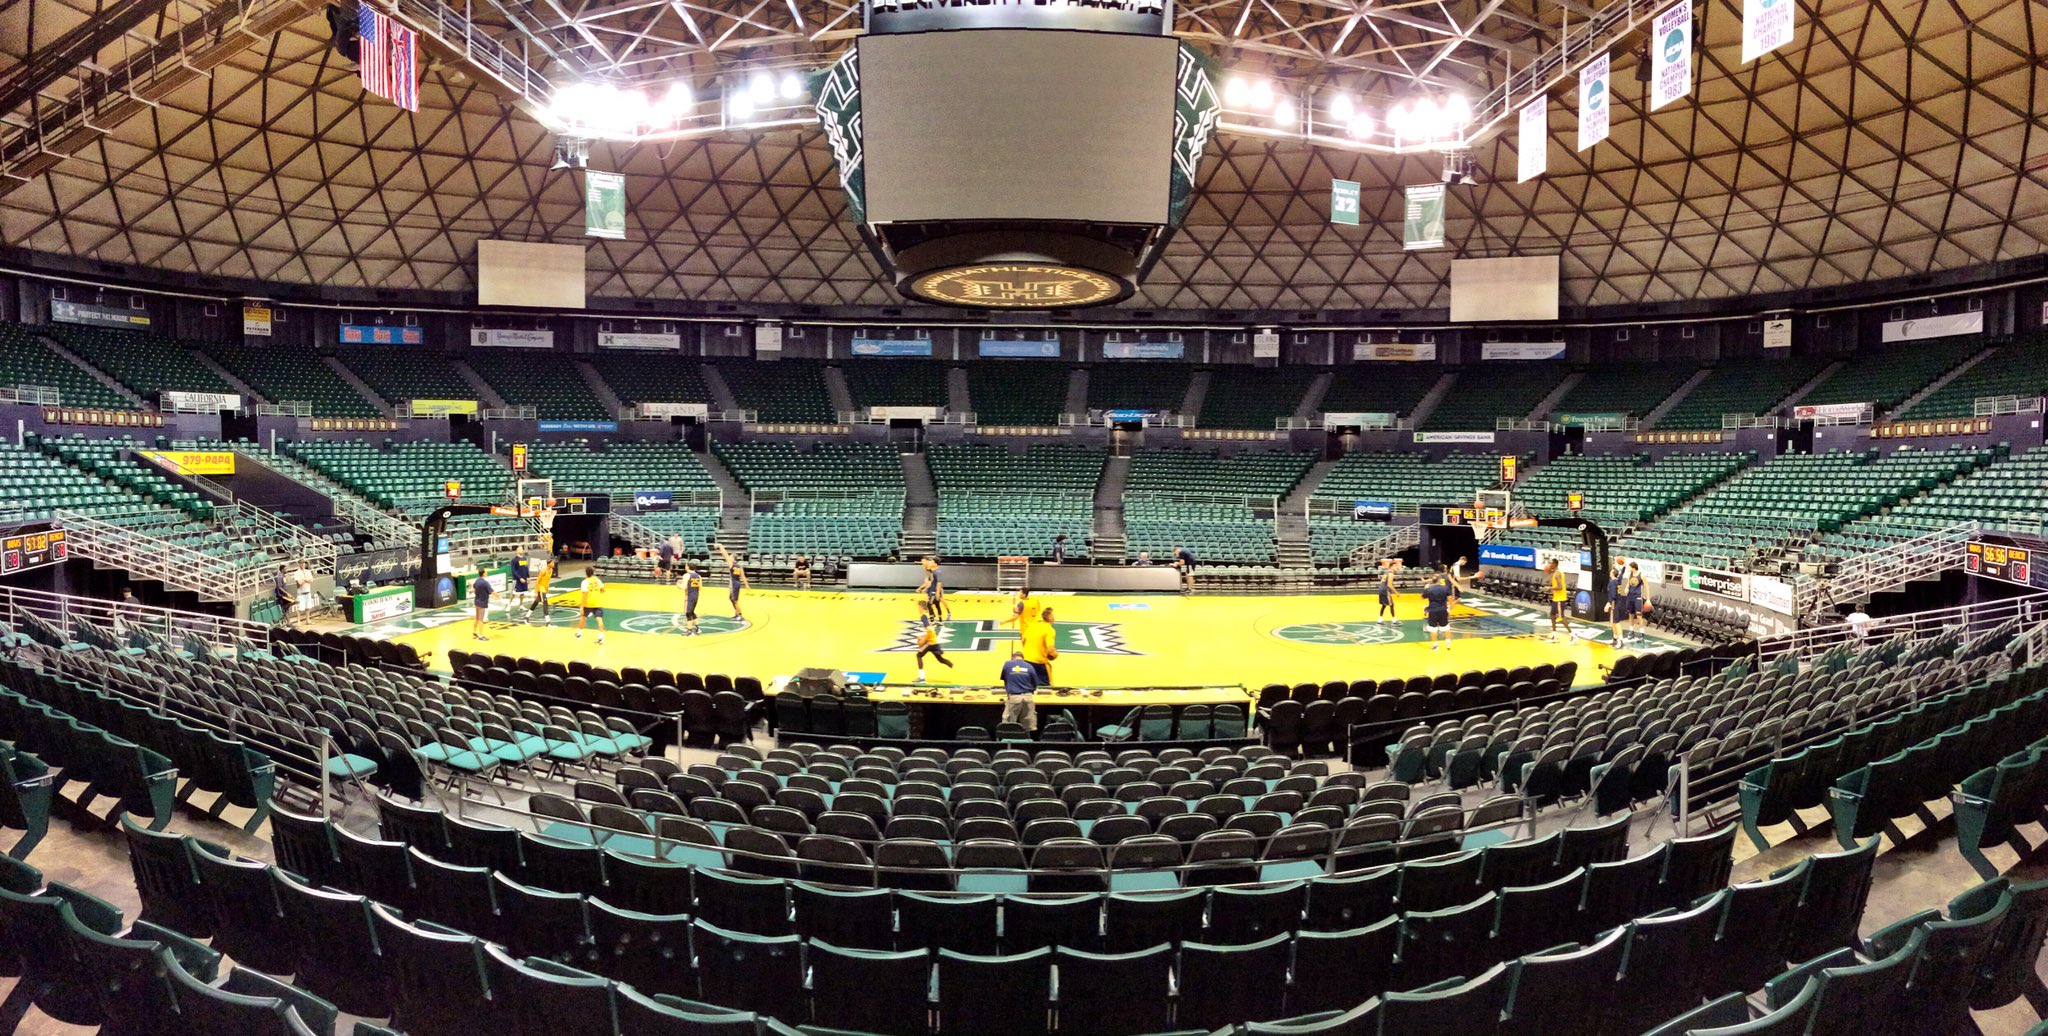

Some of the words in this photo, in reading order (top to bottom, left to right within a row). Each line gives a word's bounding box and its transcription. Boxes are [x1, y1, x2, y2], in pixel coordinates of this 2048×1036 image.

[1662, 3, 1687, 25] WOMEN'S
[1756, 2, 1787, 26] NATIONAL
[1659, 12, 1689, 36] VOLLEYBALL
[1754, 13, 1788, 39] CHAMPION
[1760, 29, 1781, 50] 1987
[1586, 57, 1607, 75] WOMEN'S
[1661, 59, 1686, 78] NATIONAL
[1660, 68, 1687, 90] CHAMPION
[1665, 82, 1682, 101] 1983
[184, 393, 227, 405] CALIFORNIA
[655, 405, 695, 415] ISLAND
[183, 455, 231, 465] 979-PAPA
[1690, 574, 1742, 592] enterprise
